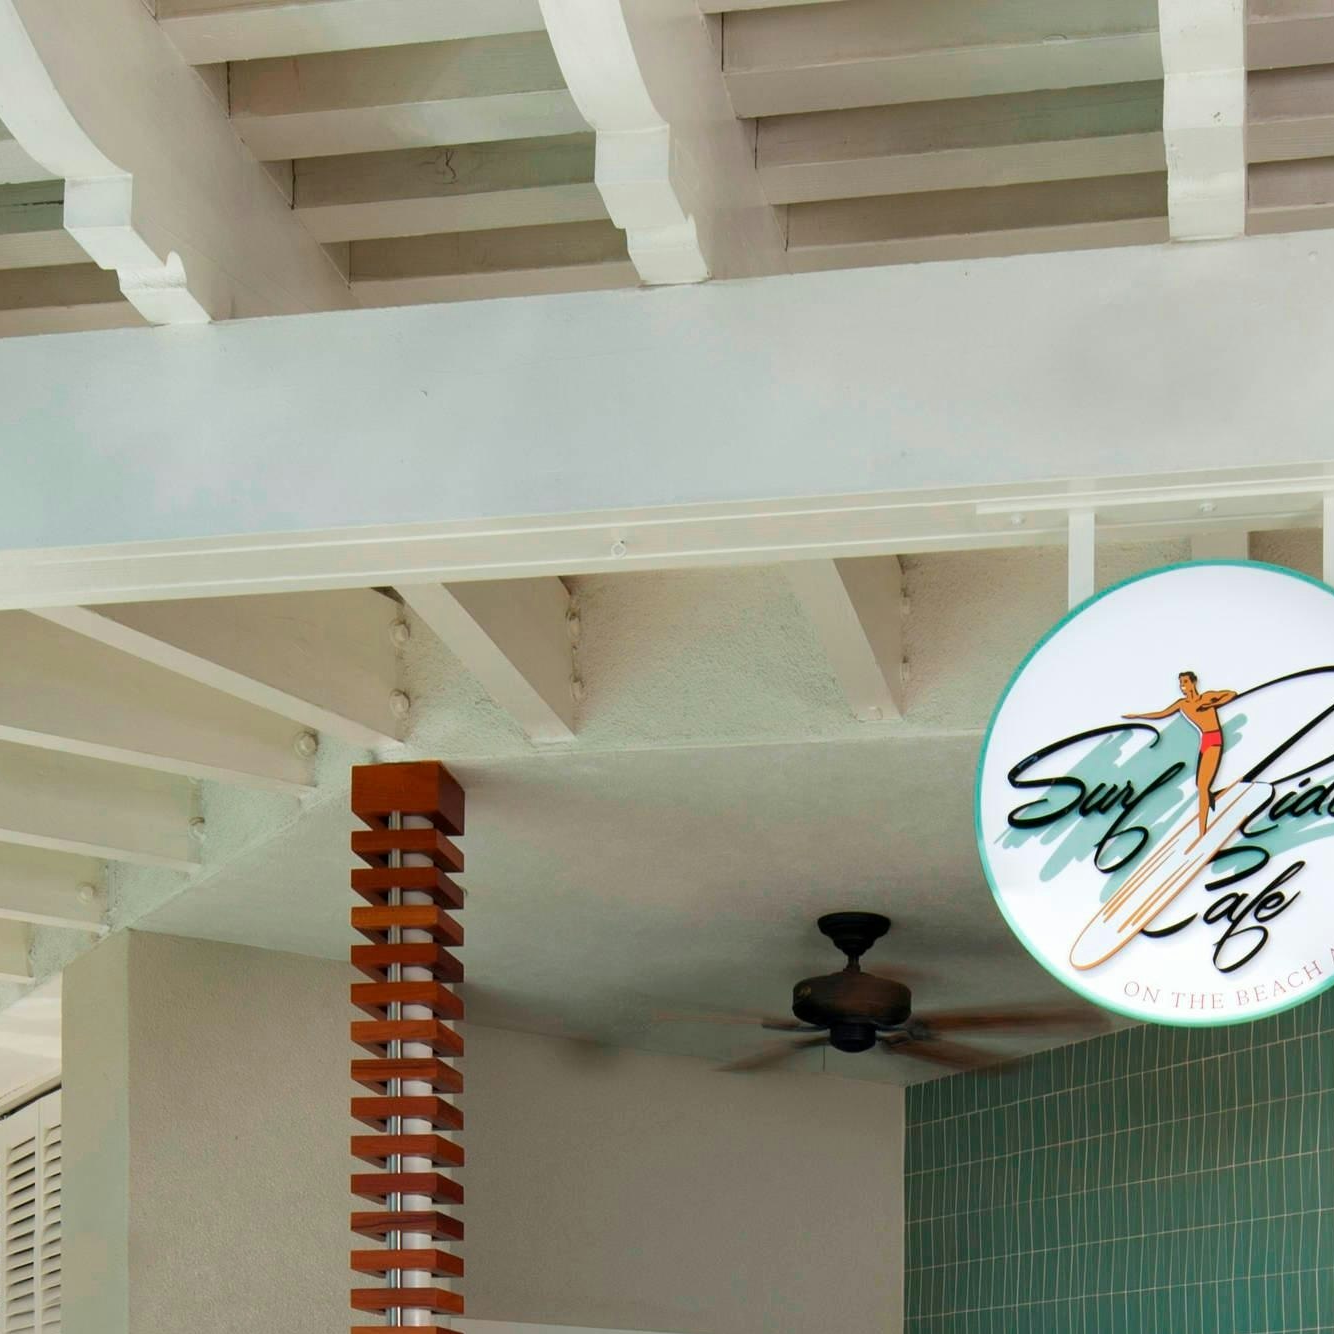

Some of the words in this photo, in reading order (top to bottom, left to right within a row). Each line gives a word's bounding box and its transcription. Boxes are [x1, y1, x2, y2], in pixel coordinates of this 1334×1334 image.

[1007, 723, 1186, 874] Surf
[1141, 846, 1307, 973] Cafe
[1123, 980, 1162, 1004] ON
[1172, 991, 1225, 1010] THE
[1237, 959, 1323, 1008] BEACH
